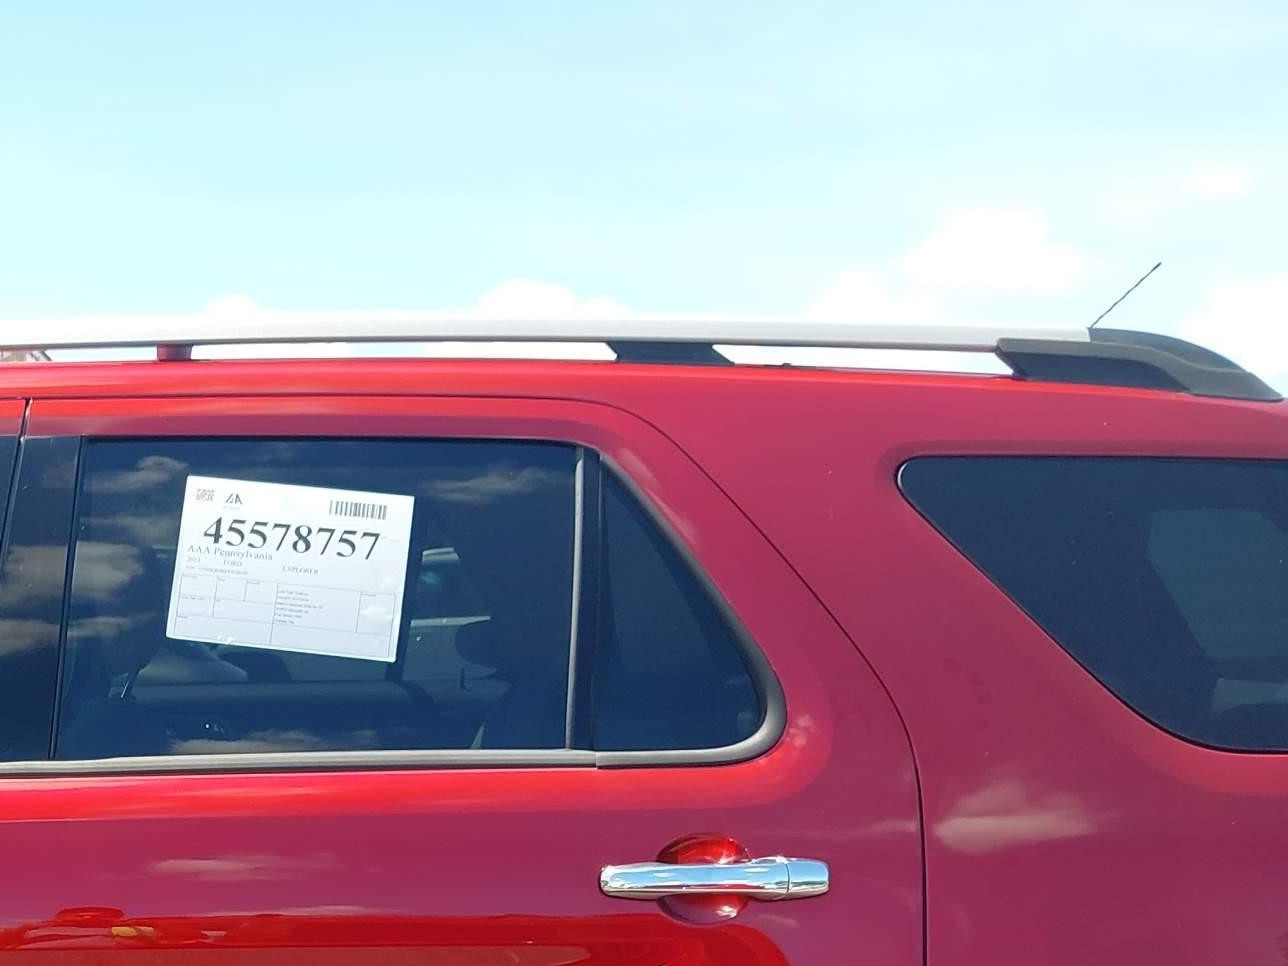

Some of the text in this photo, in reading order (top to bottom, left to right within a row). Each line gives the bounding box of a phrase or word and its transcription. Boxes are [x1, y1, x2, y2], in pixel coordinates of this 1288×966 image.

[187, 544, 273, 561] AAA Pennsylvania
[203, 516, 381, 560] 45578757
